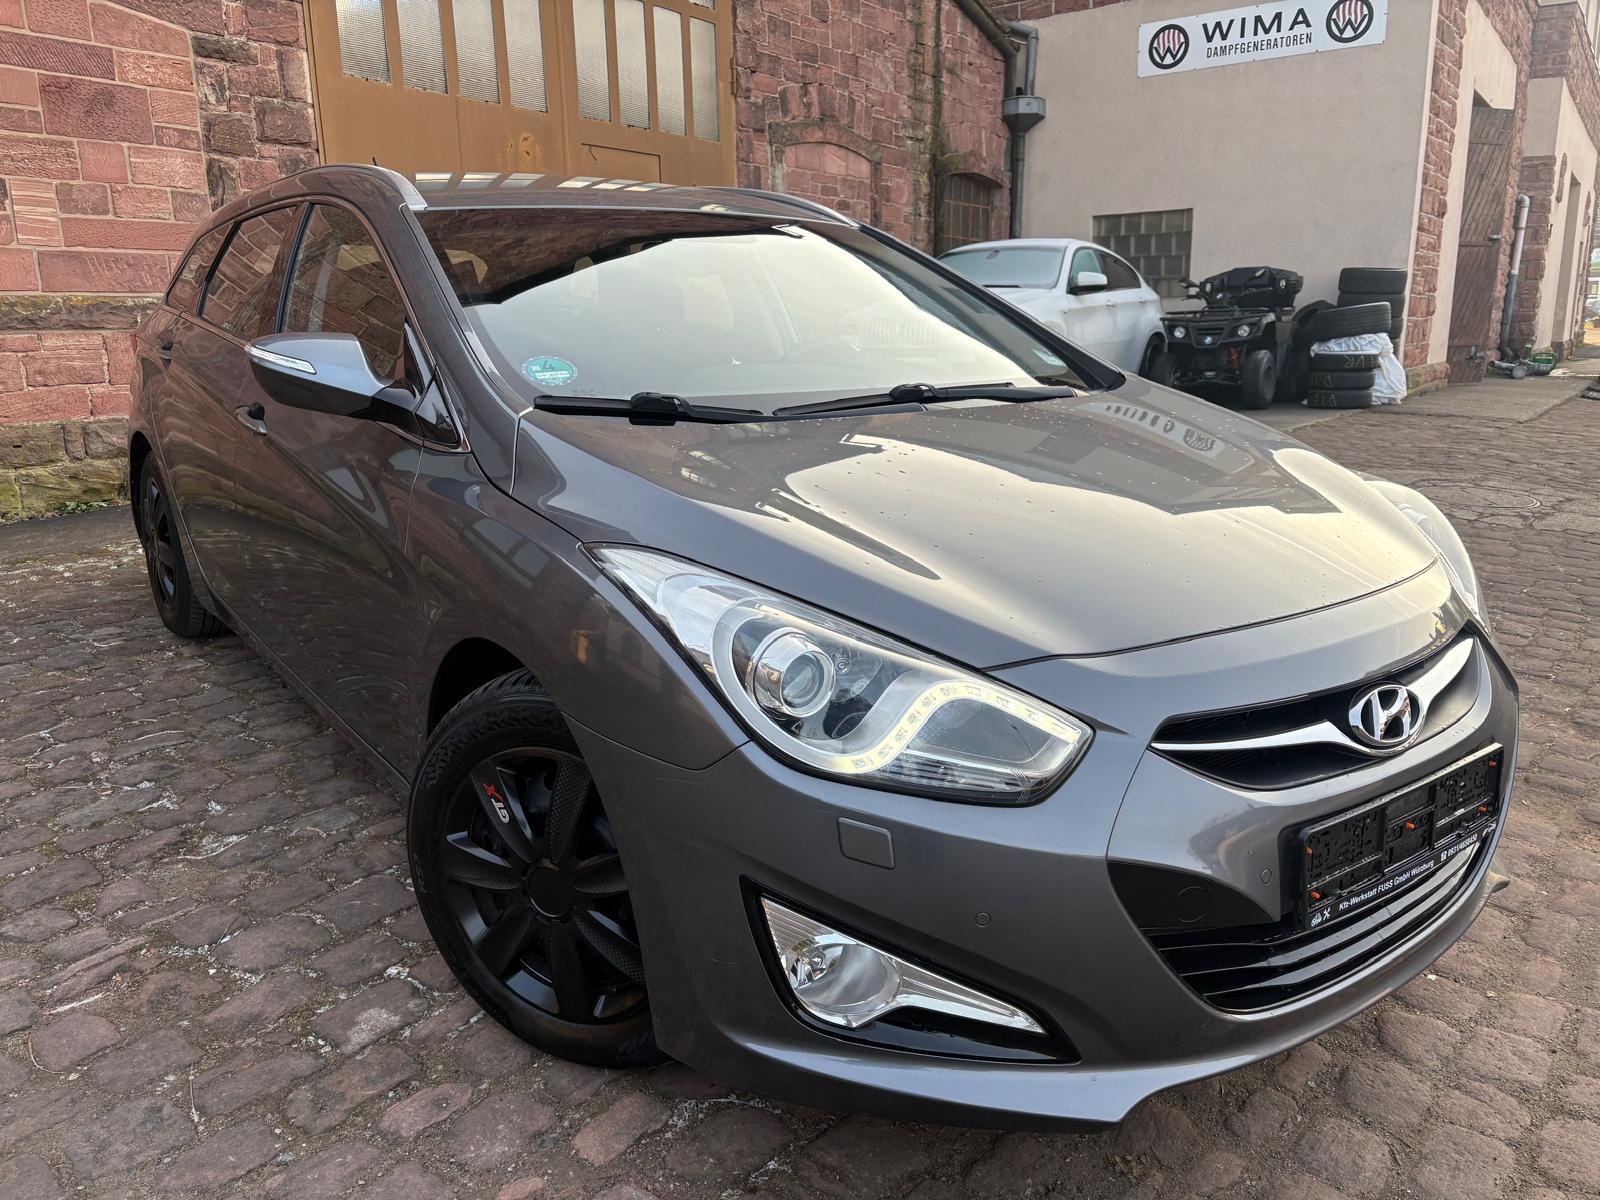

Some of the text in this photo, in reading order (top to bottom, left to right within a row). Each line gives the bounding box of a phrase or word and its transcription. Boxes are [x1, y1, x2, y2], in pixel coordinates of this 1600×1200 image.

[1202, 7, 1312, 44] WIMA
[1206, 32, 1312, 59] DAMPFGENERATOREN
[1338, 887, 1377, 911] Kfz-Werkstatt
[1377, 879, 1394, 894] FUSS
[1393, 870, 1411, 886] GmbH
[1411, 859, 1435, 877] Würzburg
